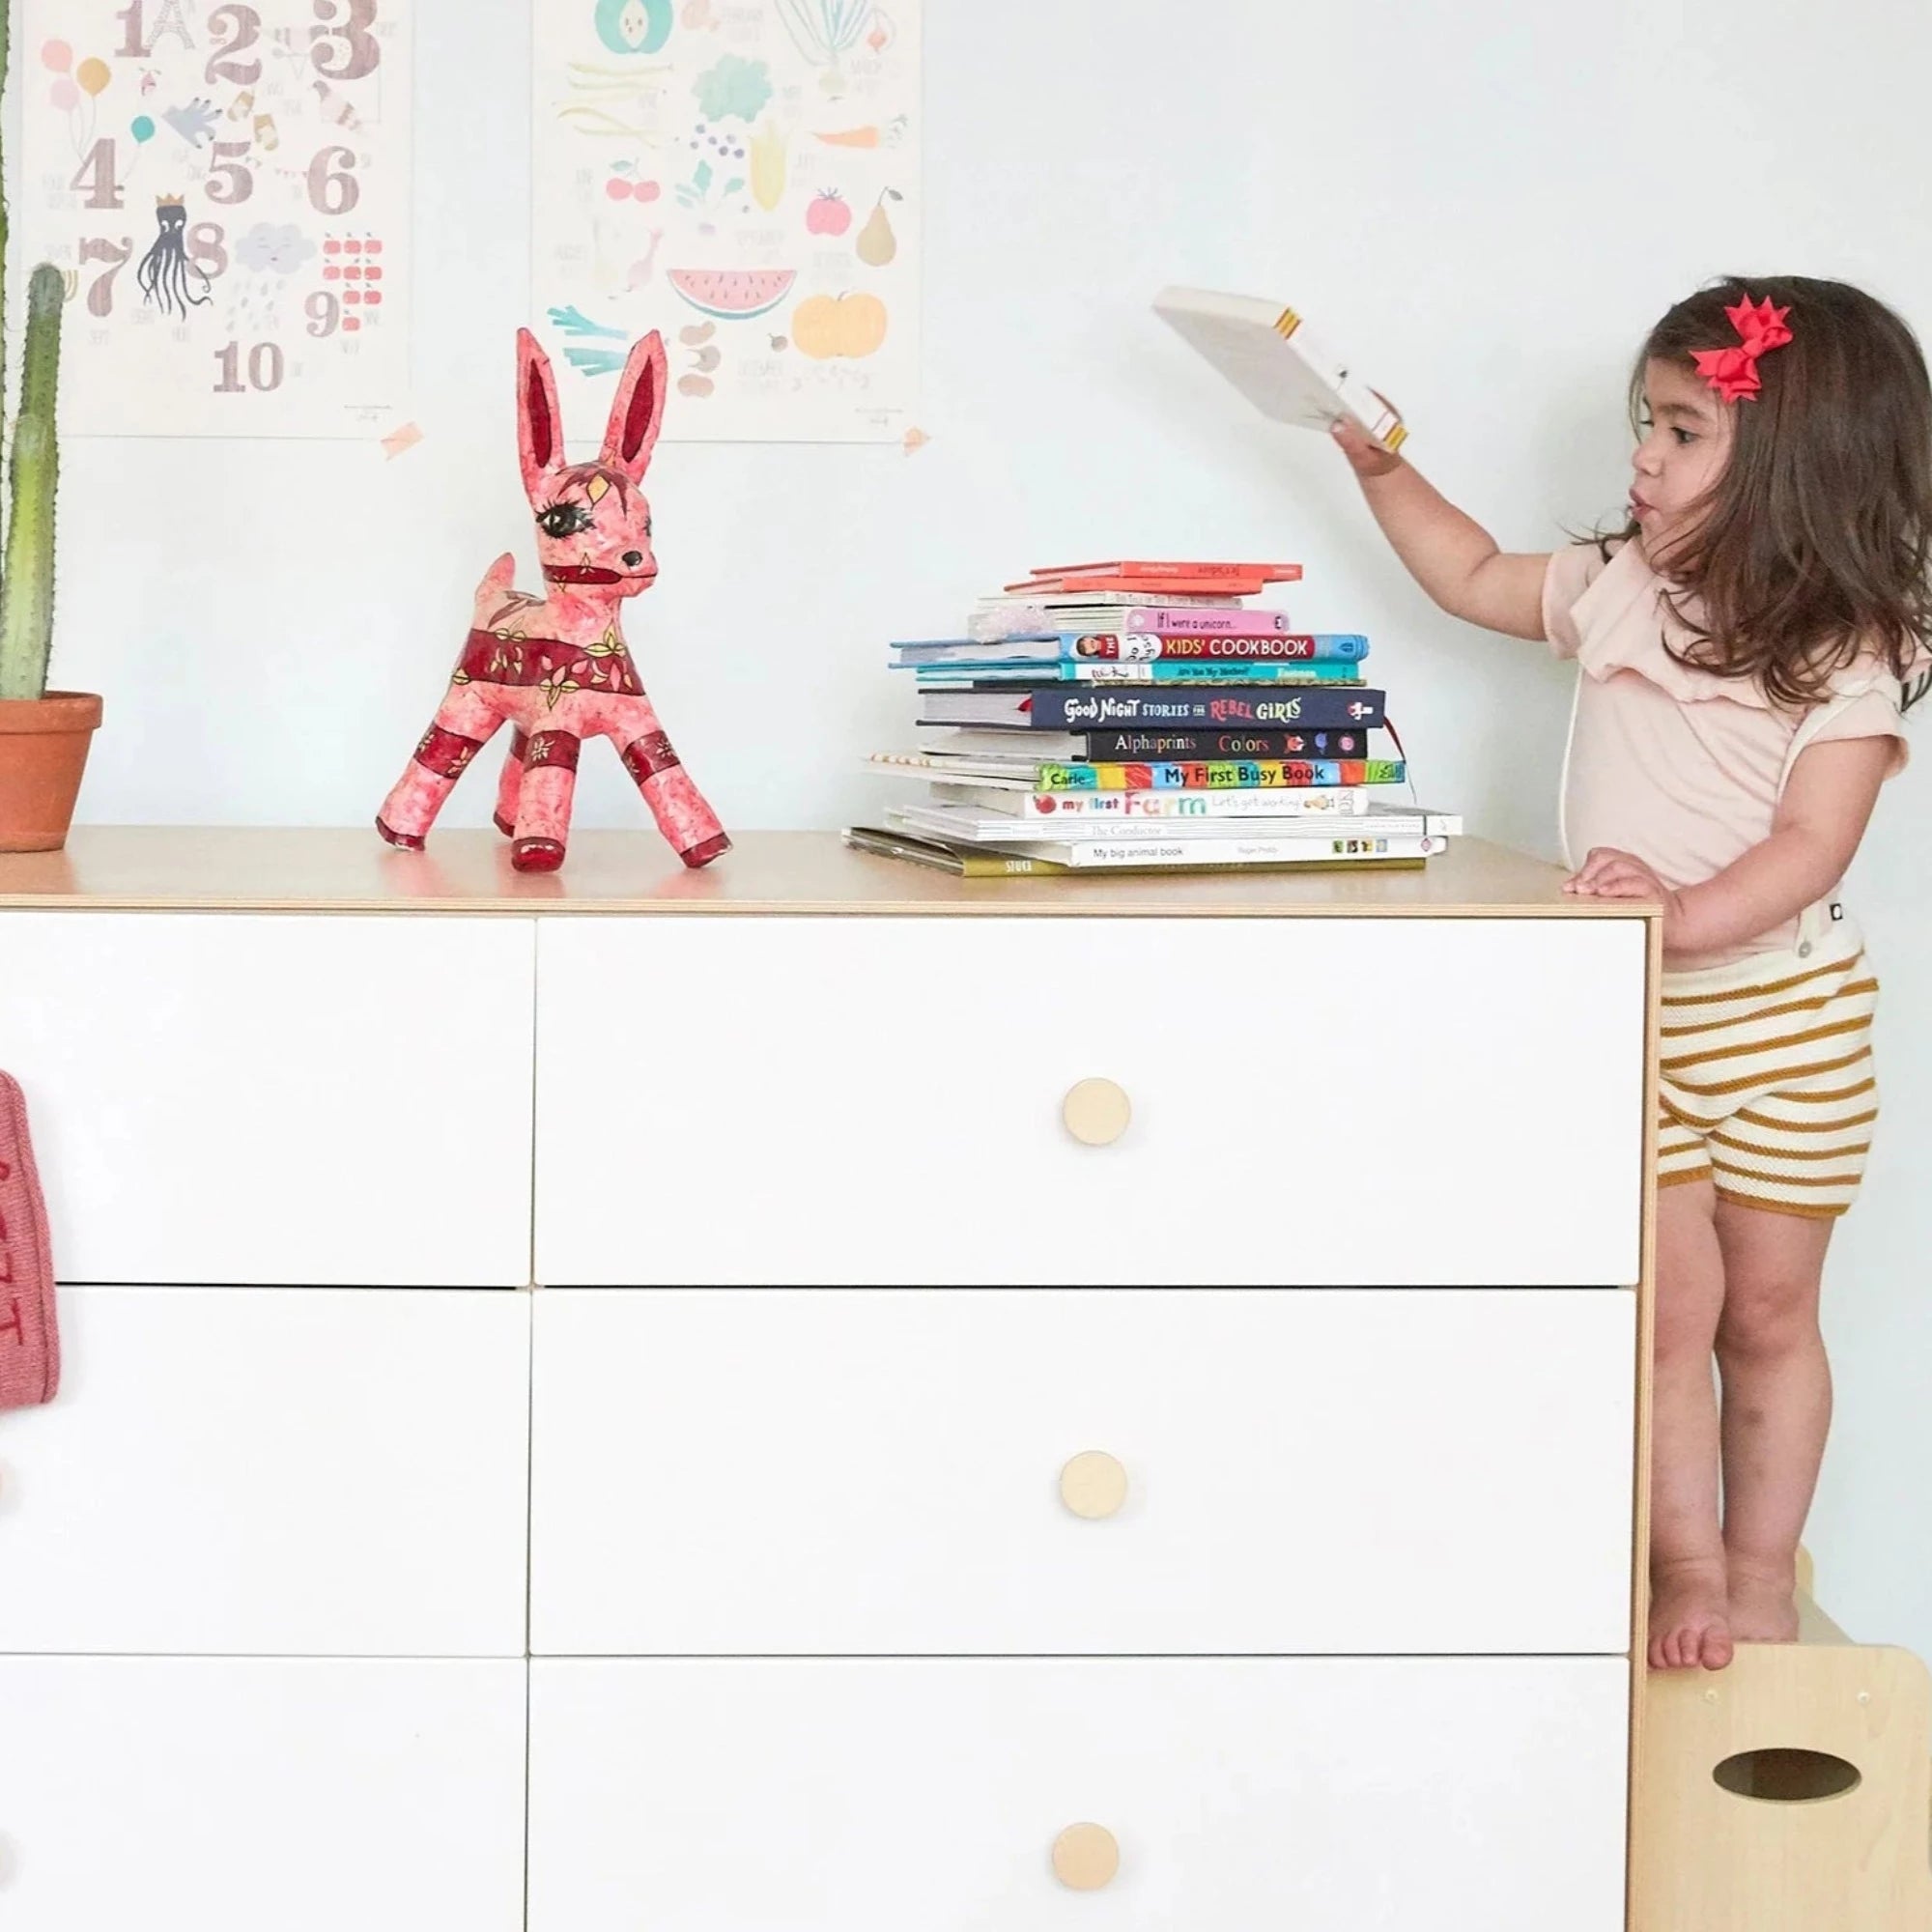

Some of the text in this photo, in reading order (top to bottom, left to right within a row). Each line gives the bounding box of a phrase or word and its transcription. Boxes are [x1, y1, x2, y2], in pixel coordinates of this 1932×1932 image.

[114, 0, 152, 57] 1
[205, 4, 262, 85] 2
[311, 0, 380, 80] 3
[71, 138, 125, 209] 4
[204, 141, 253, 205] 5
[307, 146, 359, 214] 6
[186, 222, 227, 279] 8
[79, 237, 132, 317] 7
[304, 291, 339, 337] 9
[213, 341, 284, 392] 10
[1172, 620, 1190, 629] were
[1105, 637, 1116, 655] THE
[1166, 639, 1307, 656] KIDS' COOKBOOK
[1142, 703, 1190, 717] STORIES
[1209, 698, 1255, 722] REBEL
[1115, 734, 1270, 753] Alphaprints Colors
[1050, 773, 1087, 785] Carle
[1165, 764, 1325, 786] My First Busy Book
[1063, 792, 1207, 814] my first Farm
[1091, 825, 1161, 836] The Conductor
[1094, 847, 1183, 859] My big animal book
